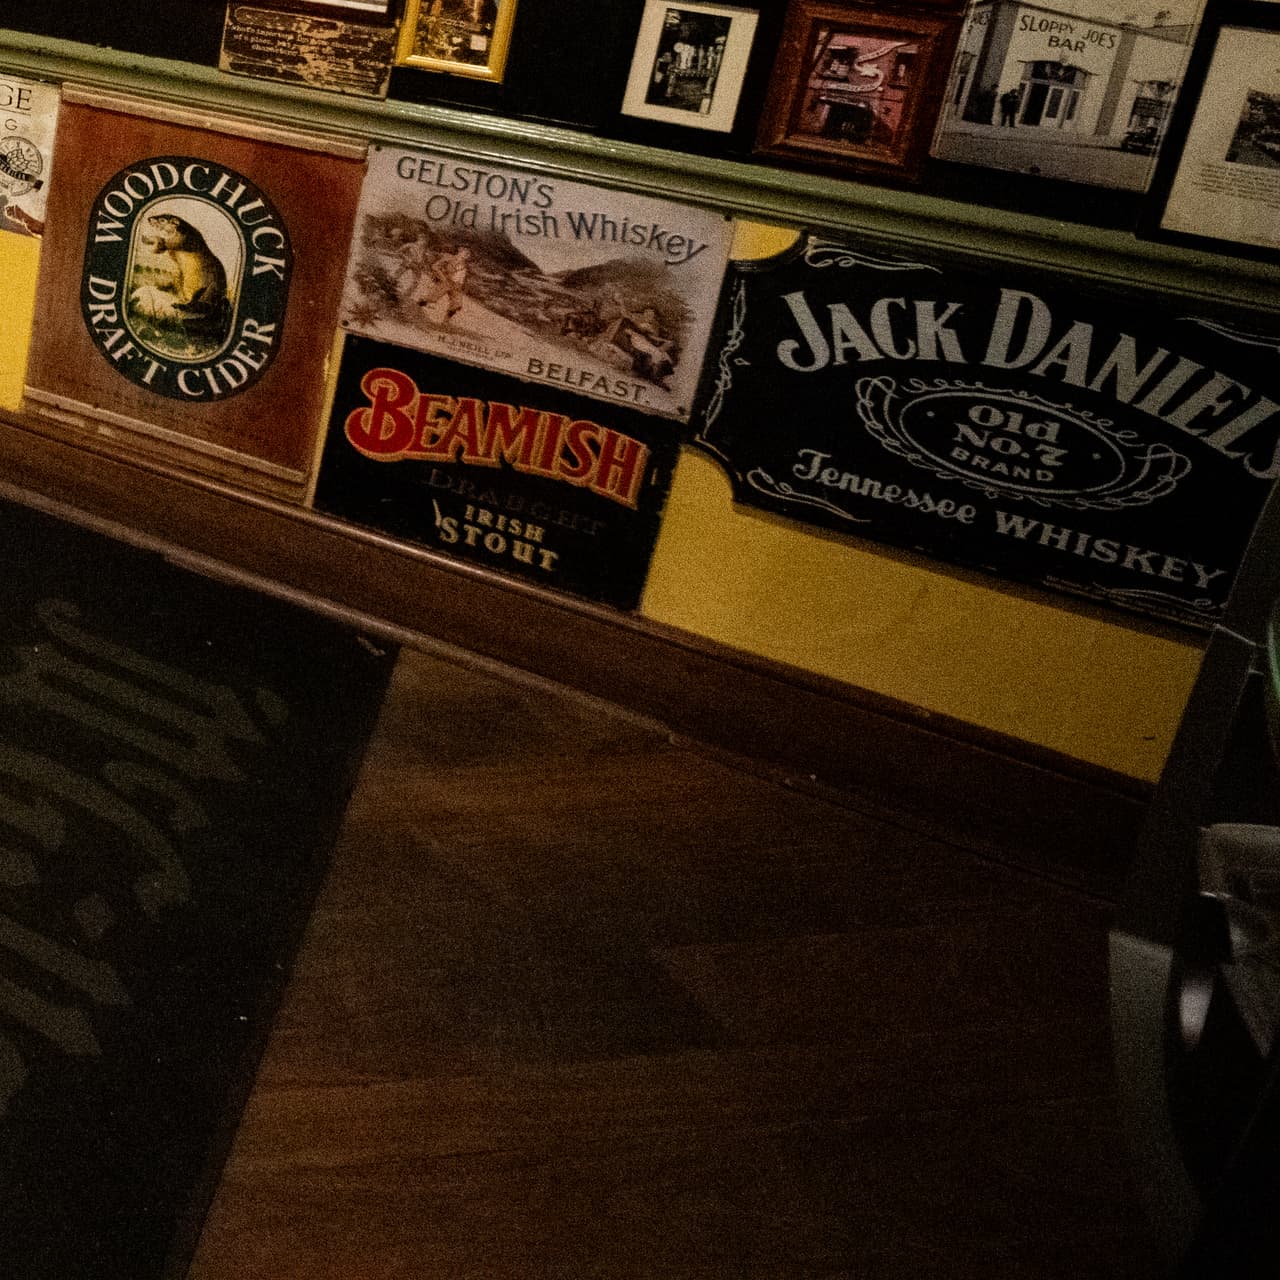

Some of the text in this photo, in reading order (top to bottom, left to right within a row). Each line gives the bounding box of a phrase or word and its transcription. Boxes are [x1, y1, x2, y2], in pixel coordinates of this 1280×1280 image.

[1019, 15, 1117, 49] SLOPPY JOES
[1047, 35, 1086, 52] BAR
[396, 155, 555, 210] GELSTON'S
[94, 161, 286, 281] WOODCHUCK
[425, 193, 708, 266] Old Irish Whiskey
[88, 274, 276, 397] DRAFT CIDER
[776, 290, 968, 373] JACK
[526, 356, 650, 405] BELFAST.
[344, 367, 648, 511] BEAMISH
[967, 403, 1061, 444] Old
[949, 446, 1057, 485] BRAND
[439, 517, 559, 572] STOUT
[464, 504, 546, 543] IRISH
[792, 447, 1228, 591] Tennessee WHISKEY
